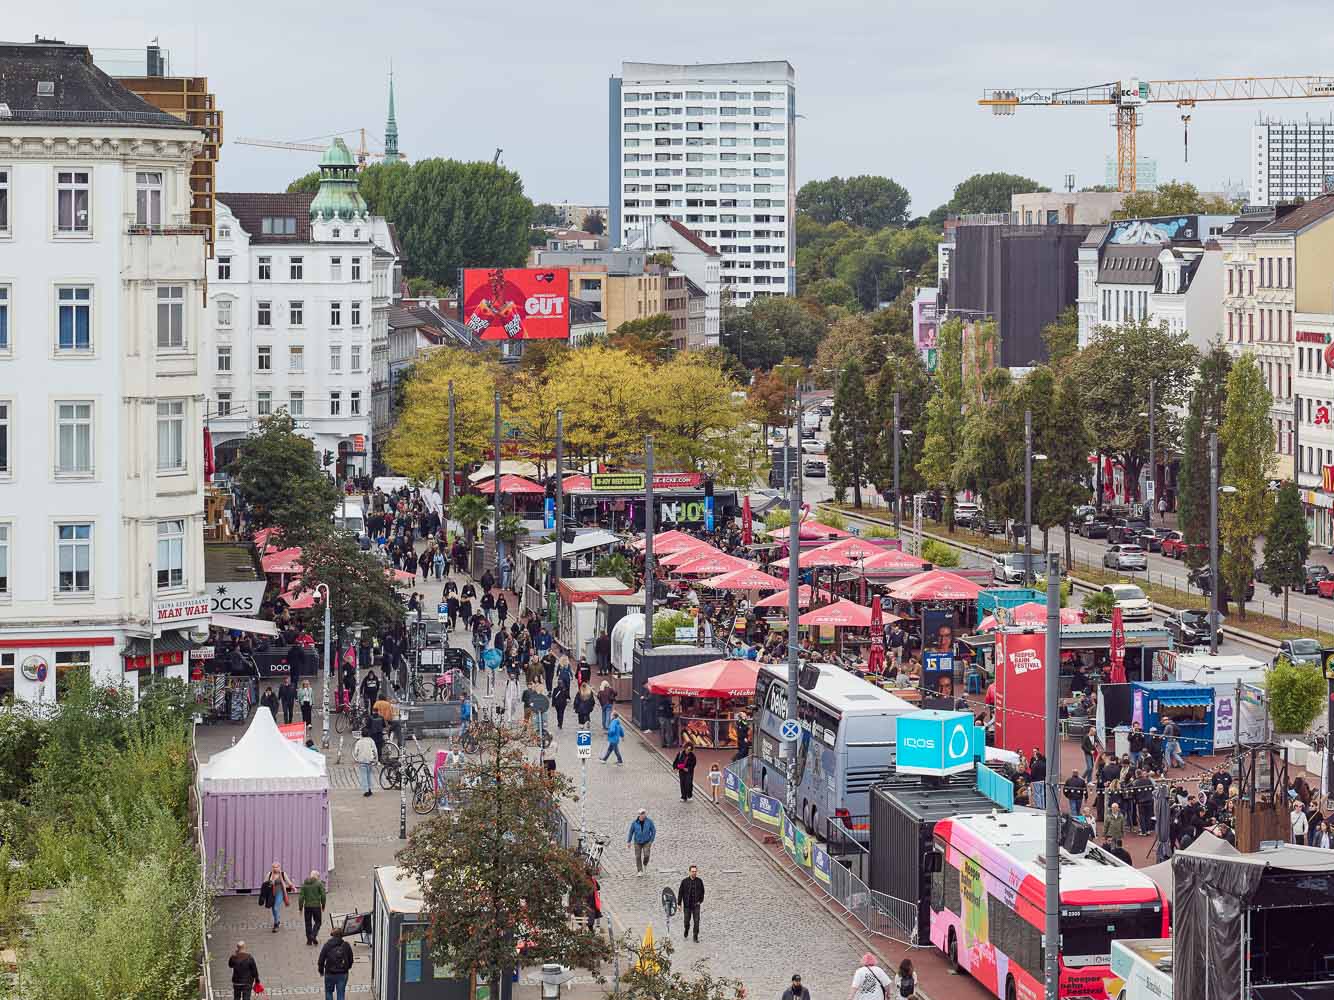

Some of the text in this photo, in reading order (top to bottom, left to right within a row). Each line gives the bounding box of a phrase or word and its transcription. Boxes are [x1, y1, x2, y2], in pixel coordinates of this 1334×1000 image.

[525, 296, 565, 315] GUT
[158, 604, 209, 619] MAN WAH
[903, 737, 936, 749] IQOS
[1067, 976, 1101, 985] Reeper
